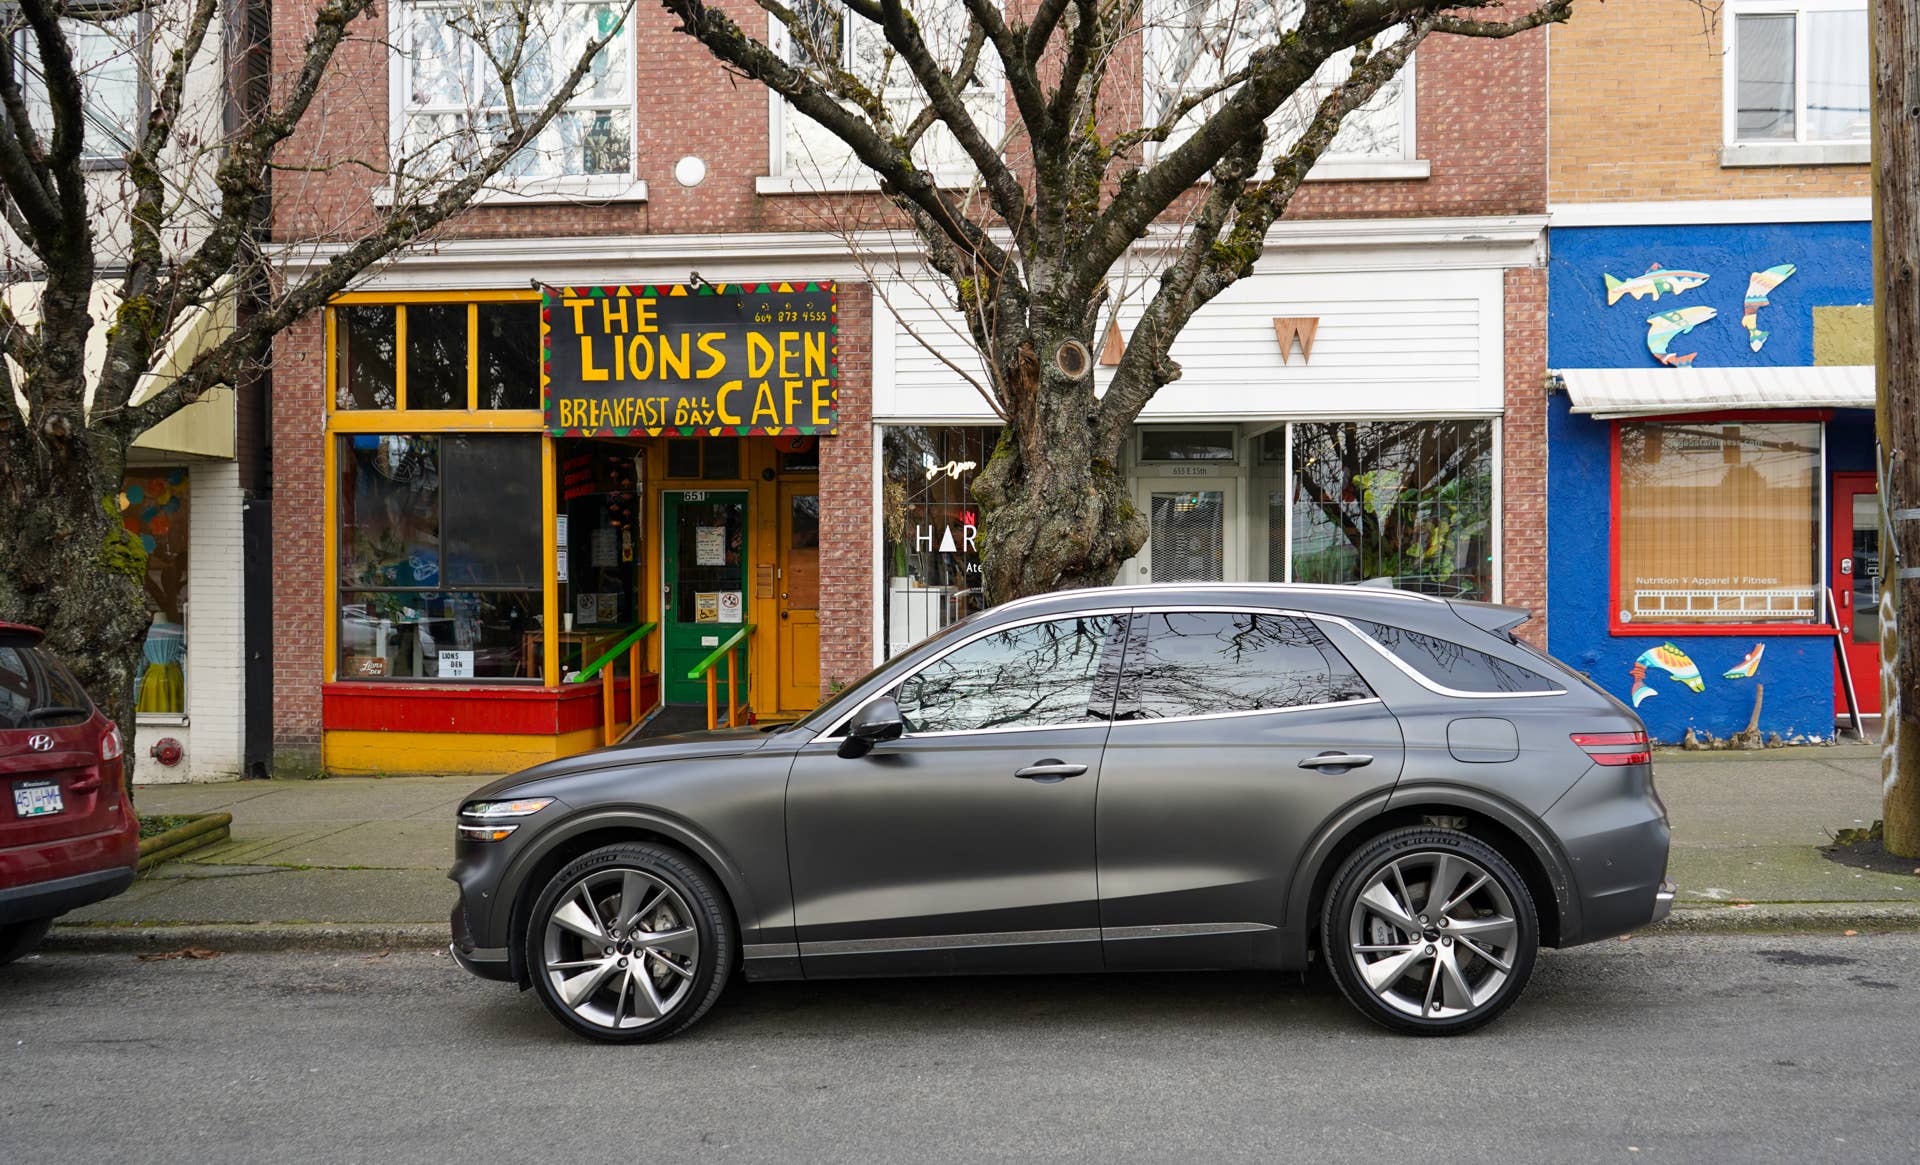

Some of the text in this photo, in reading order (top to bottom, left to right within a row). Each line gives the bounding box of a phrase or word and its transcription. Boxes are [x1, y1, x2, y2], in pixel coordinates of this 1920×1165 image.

[563, 298, 658, 335] THE
[754, 311, 827, 323] 604 873 4555
[746, 332, 826, 378] DEN
[559, 397, 715, 428] BREAKFAST ALL DAY
[716, 379, 830, 425] CAFE
[685, 491, 703, 501] 651
[916, 525, 977, 552] HAR
[966, 562, 982, 573] Ate
[1636, 576, 1679, 585] Nutrition
[1692, 576, 1730, 586] Apparel
[1742, 576, 1777, 585] Fitness
